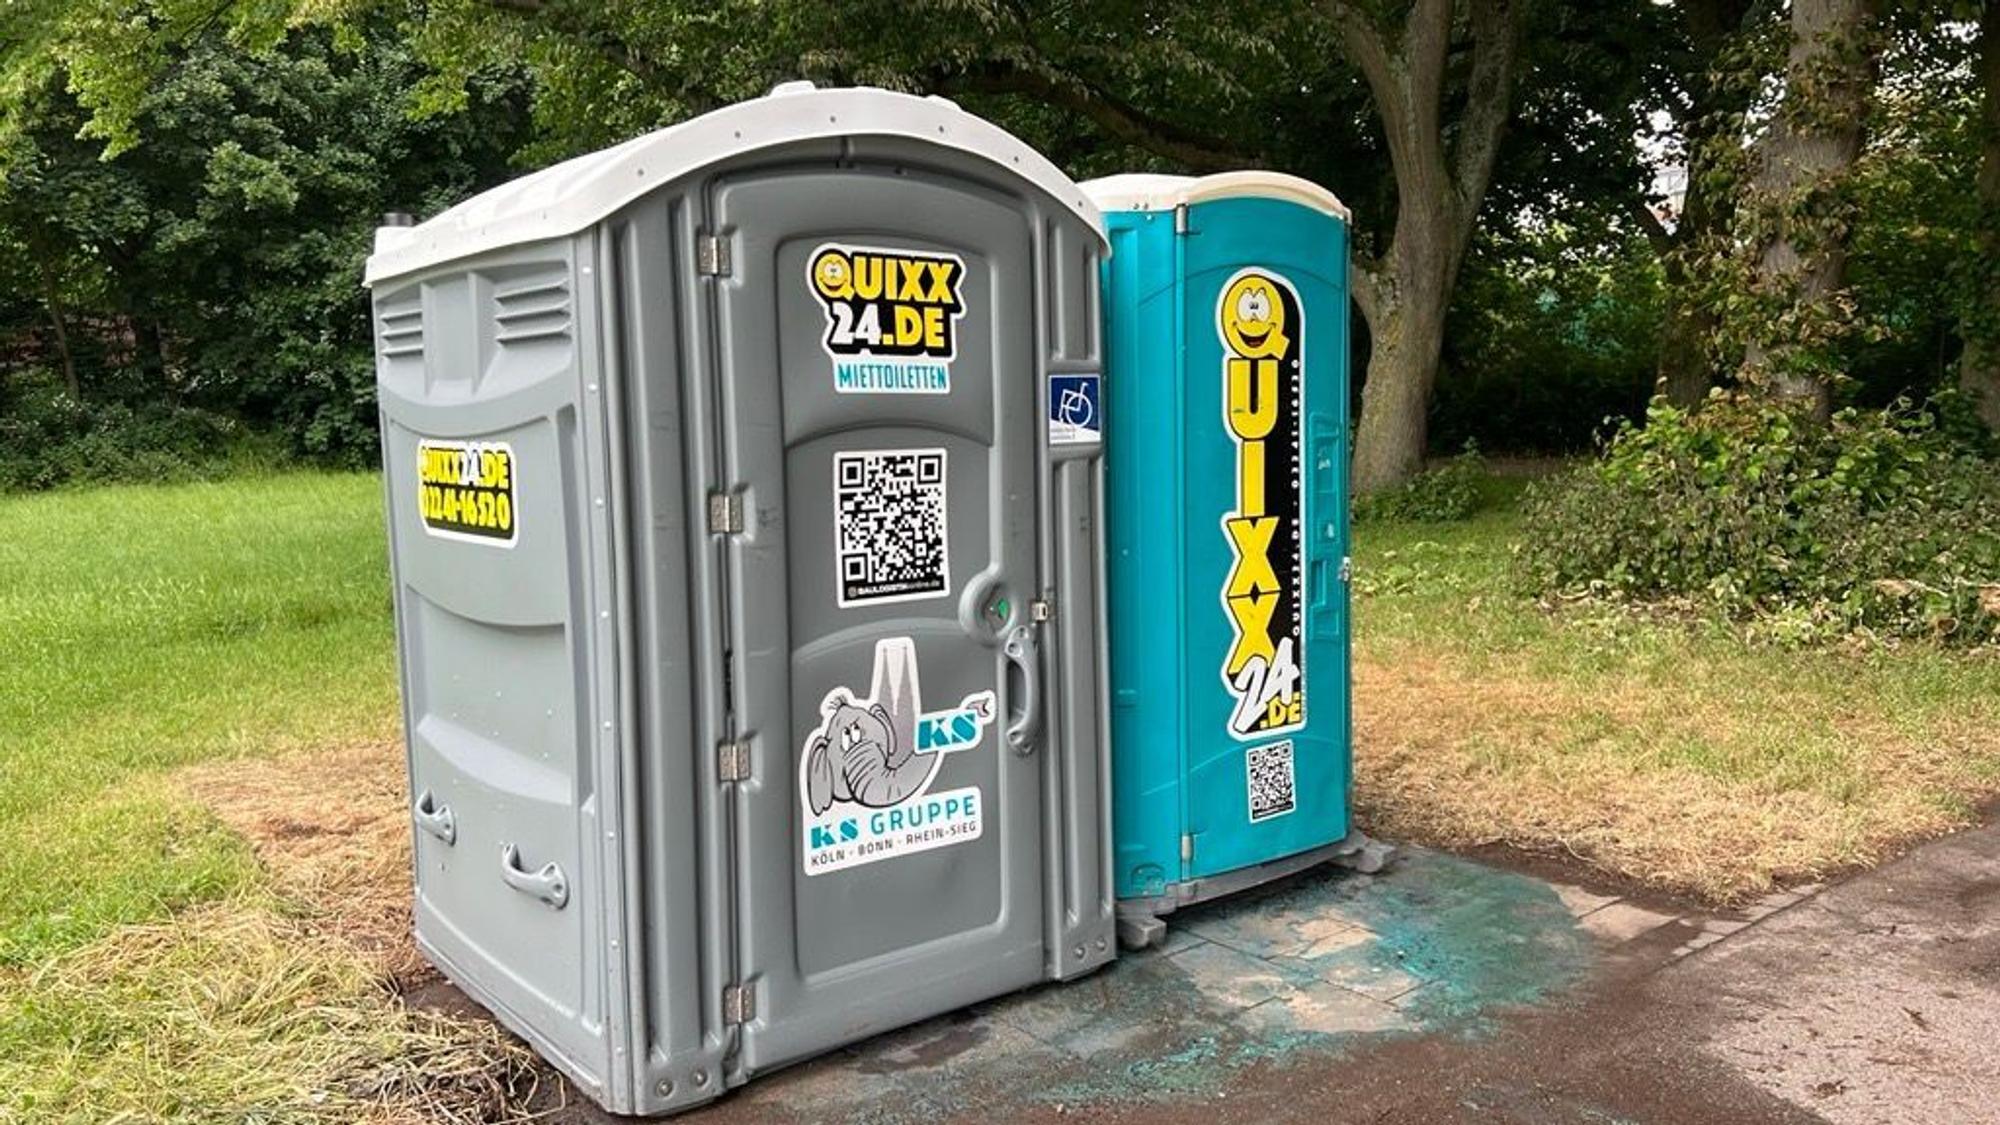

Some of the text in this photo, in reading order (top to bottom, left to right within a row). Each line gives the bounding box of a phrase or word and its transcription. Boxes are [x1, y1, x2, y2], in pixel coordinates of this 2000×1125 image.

[815, 253, 955, 303] QUIXX
[830, 301, 946, 348] 24.DE
[837, 363, 947, 389] MIETTOILETTEN
[918, 713, 977, 750] KS
[810, 795, 977, 849] KS GRUPPE
[858, 838, 894, 857] BONN
